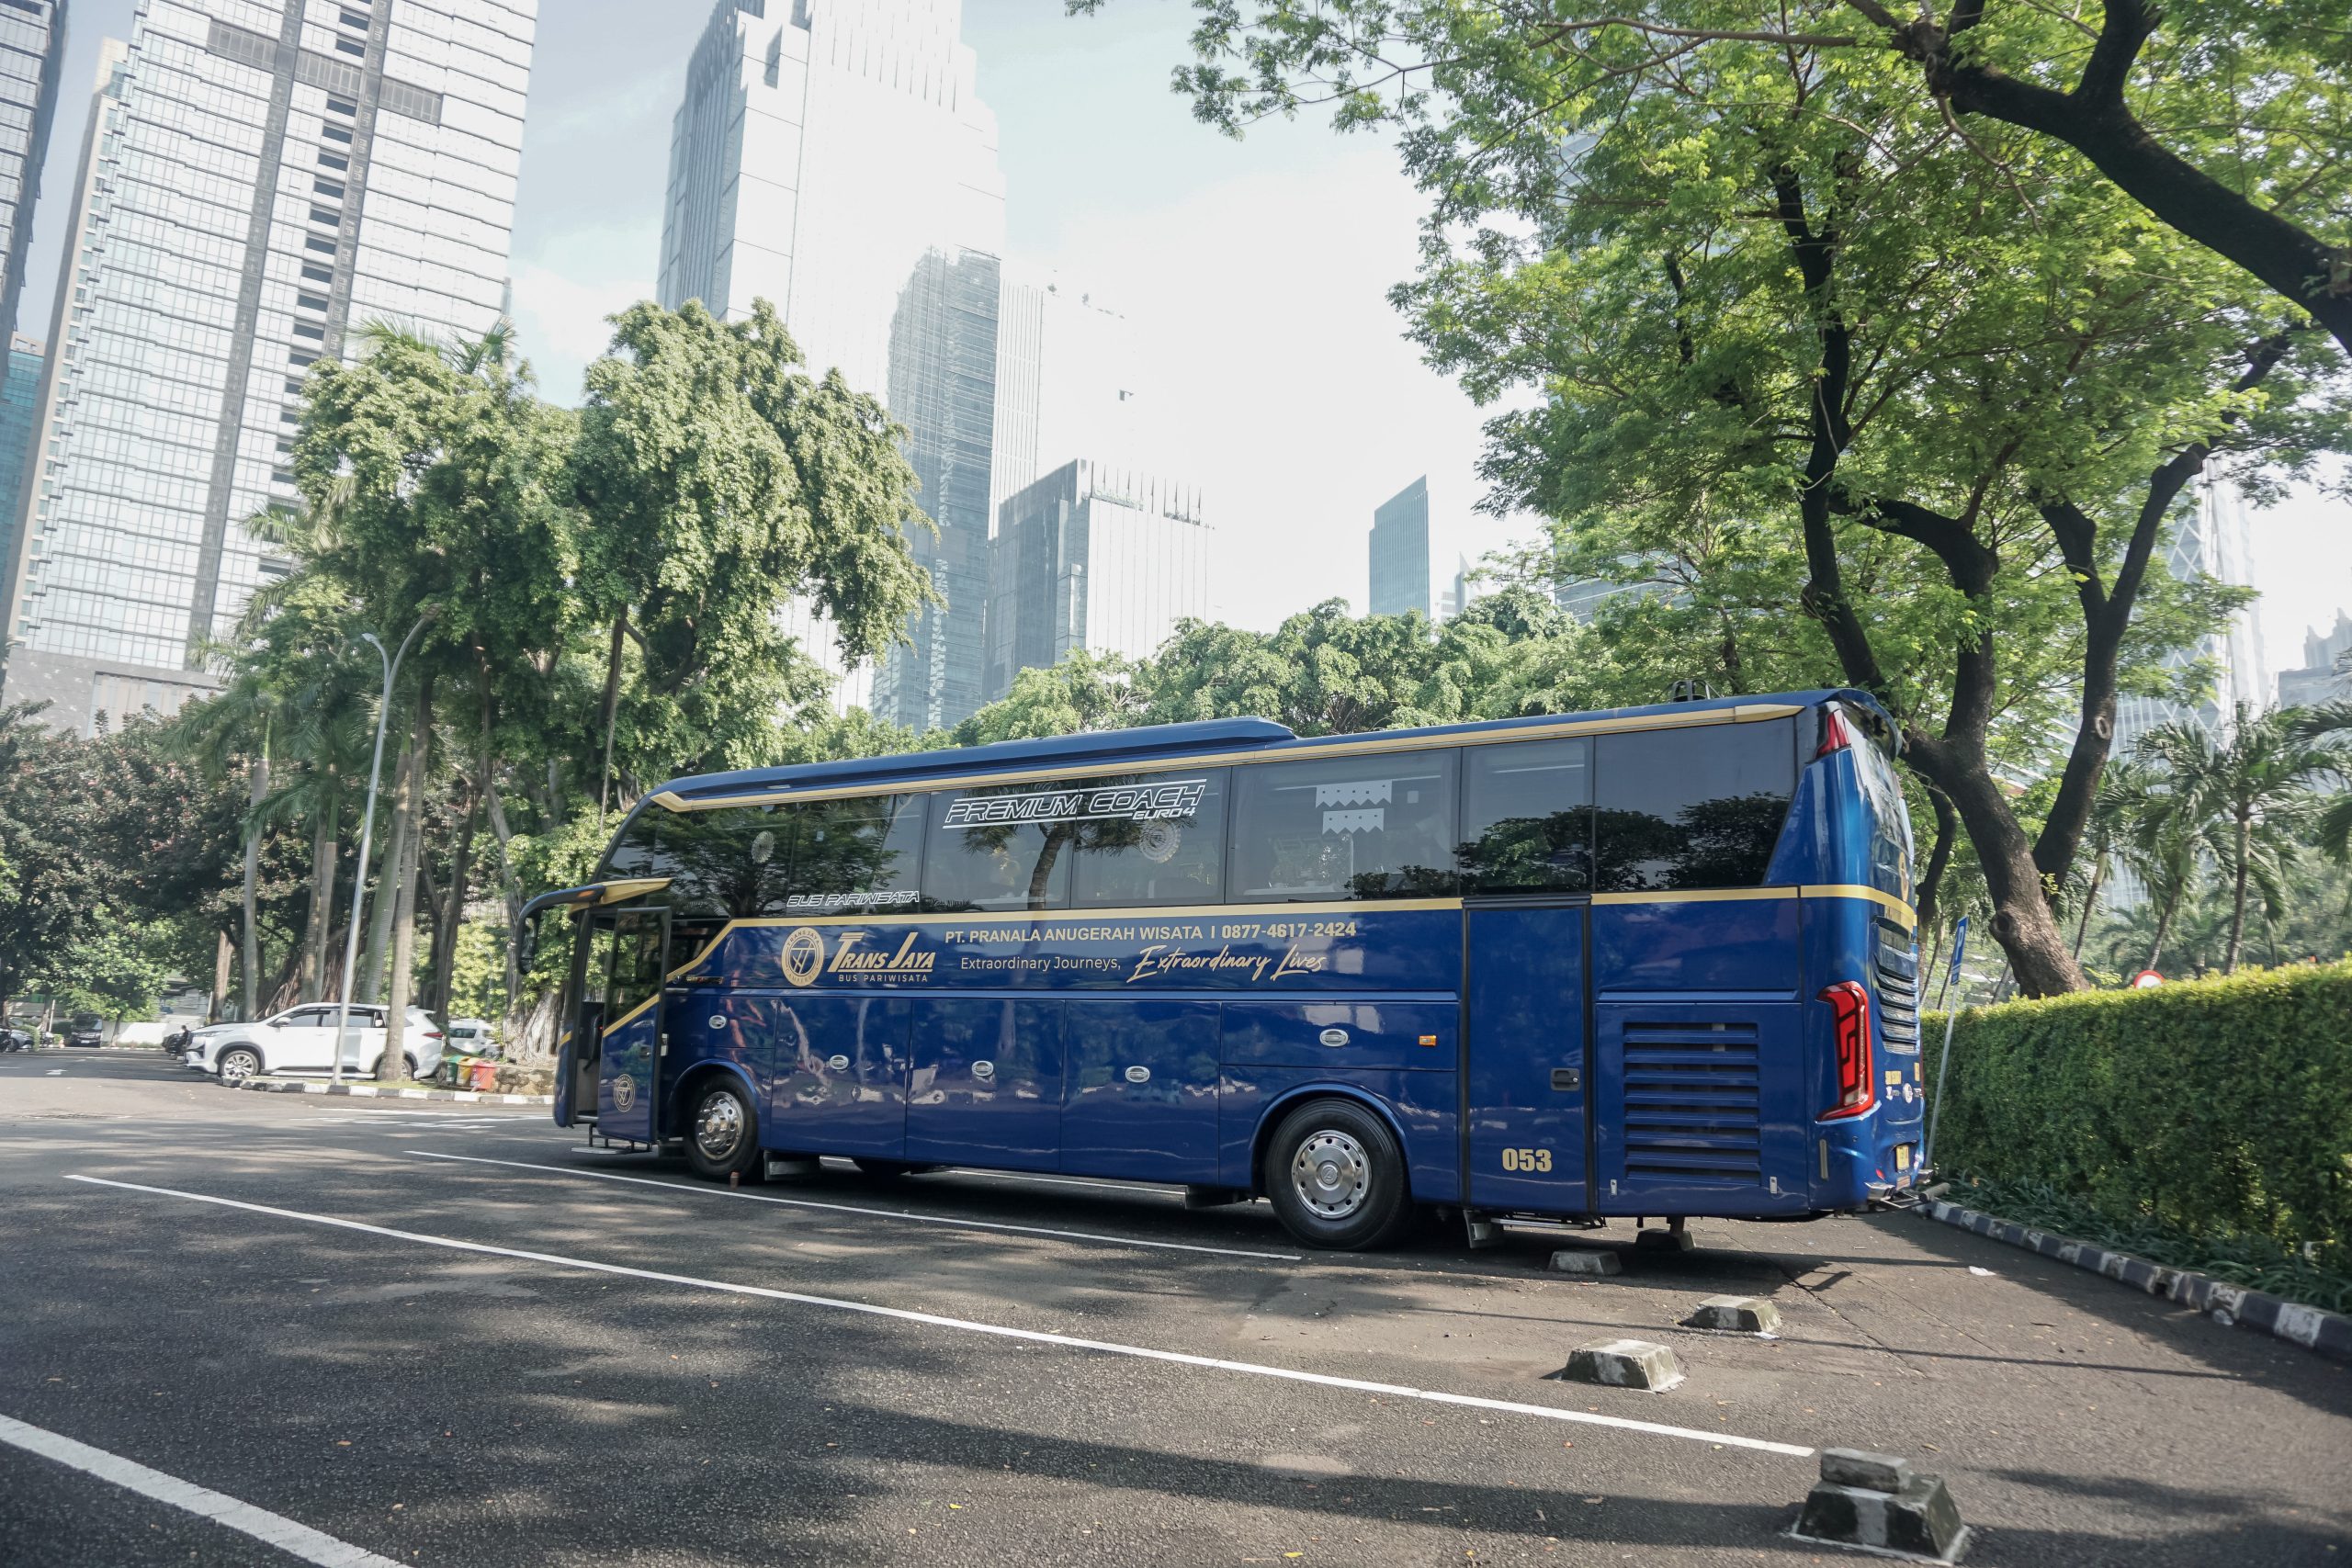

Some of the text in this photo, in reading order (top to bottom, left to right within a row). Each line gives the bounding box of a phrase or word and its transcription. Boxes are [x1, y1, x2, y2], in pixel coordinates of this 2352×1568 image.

[944, 784, 1205, 823] PREMIUM COACH
[786, 890, 920, 908] BUS PARIWISATA
[944, 931, 966, 943] PT.
[969, 929, 1042, 942] PRANALA
[1043, 927, 1135, 942] ANUGERAH
[1139, 925, 1204, 941] WISATA
[1221, 921, 1357, 939] 0877-4617-2424
[960, 956, 1121, 972] Extraordinary Journeys,
[1125, 942, 1327, 984] Extraordinary Lives
[838, 974, 928, 983] BUS PARIWISATA
[1502, 1147, 1553, 1172] 053
